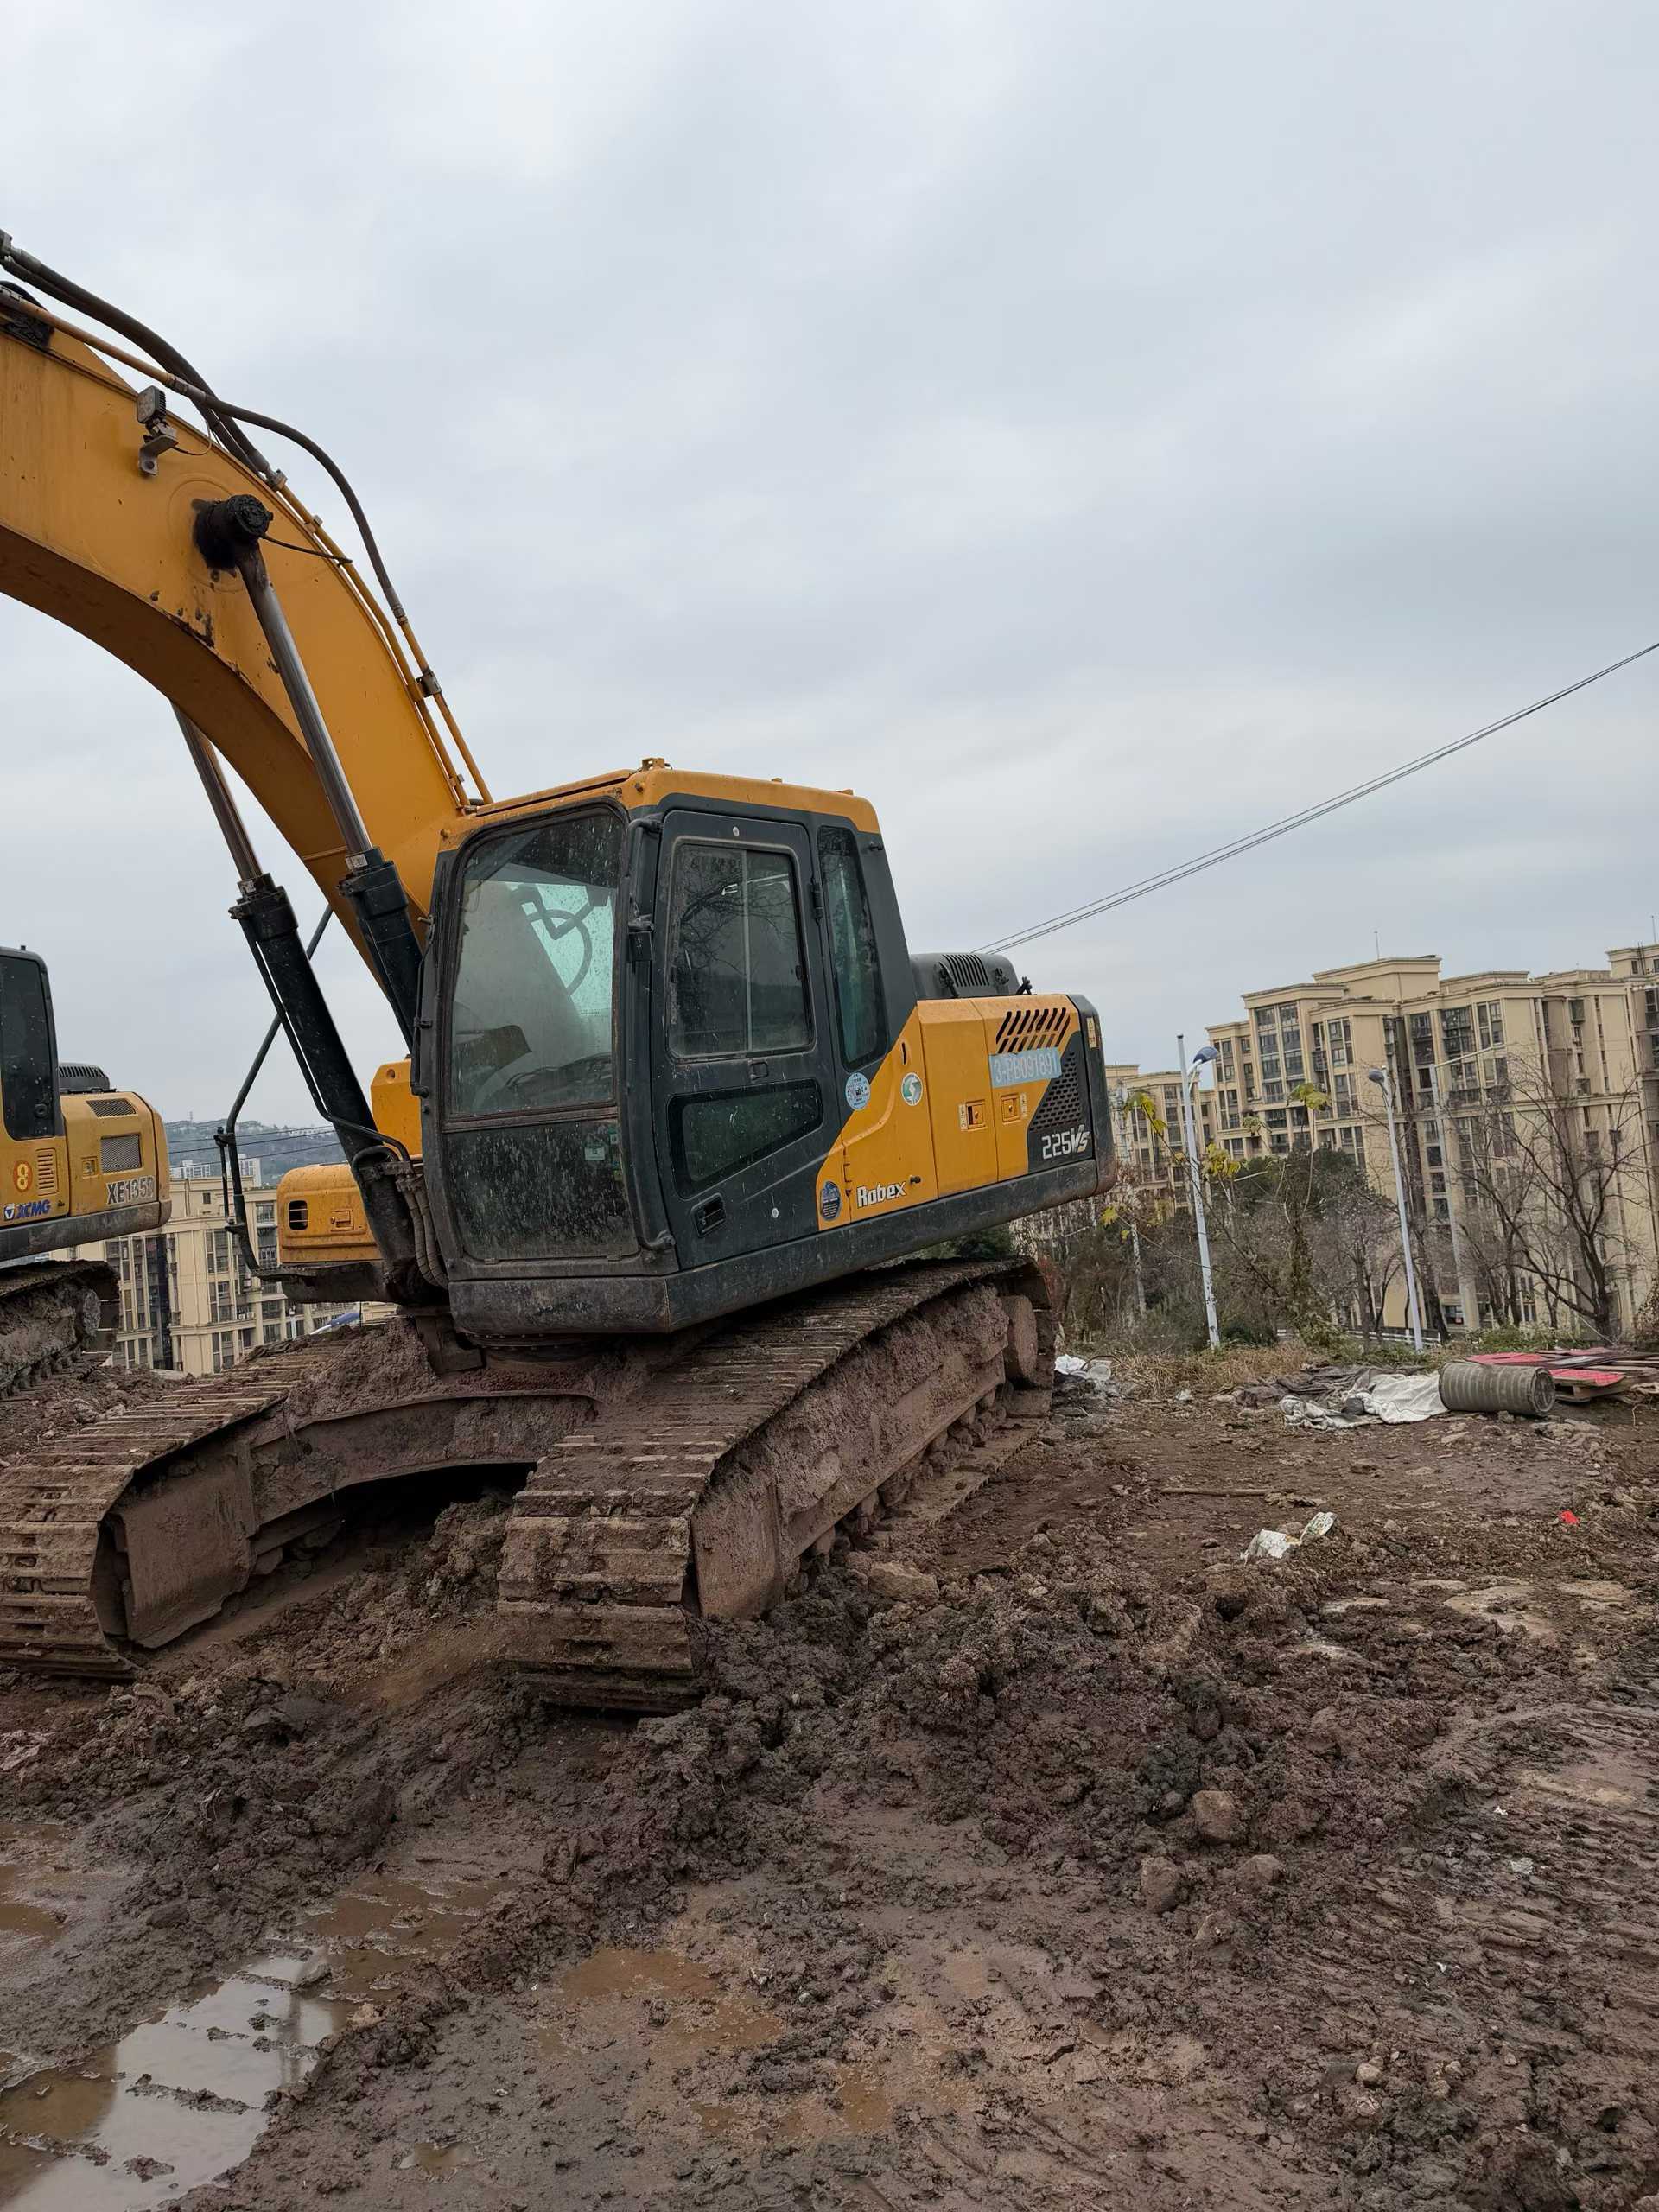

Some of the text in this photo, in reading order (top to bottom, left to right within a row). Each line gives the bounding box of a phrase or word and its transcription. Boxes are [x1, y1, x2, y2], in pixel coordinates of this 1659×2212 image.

[16, 1163, 29, 1191] 8
[856, 1181, 907, 1209] Robex
[16, 1200, 51, 1219] XCMG
